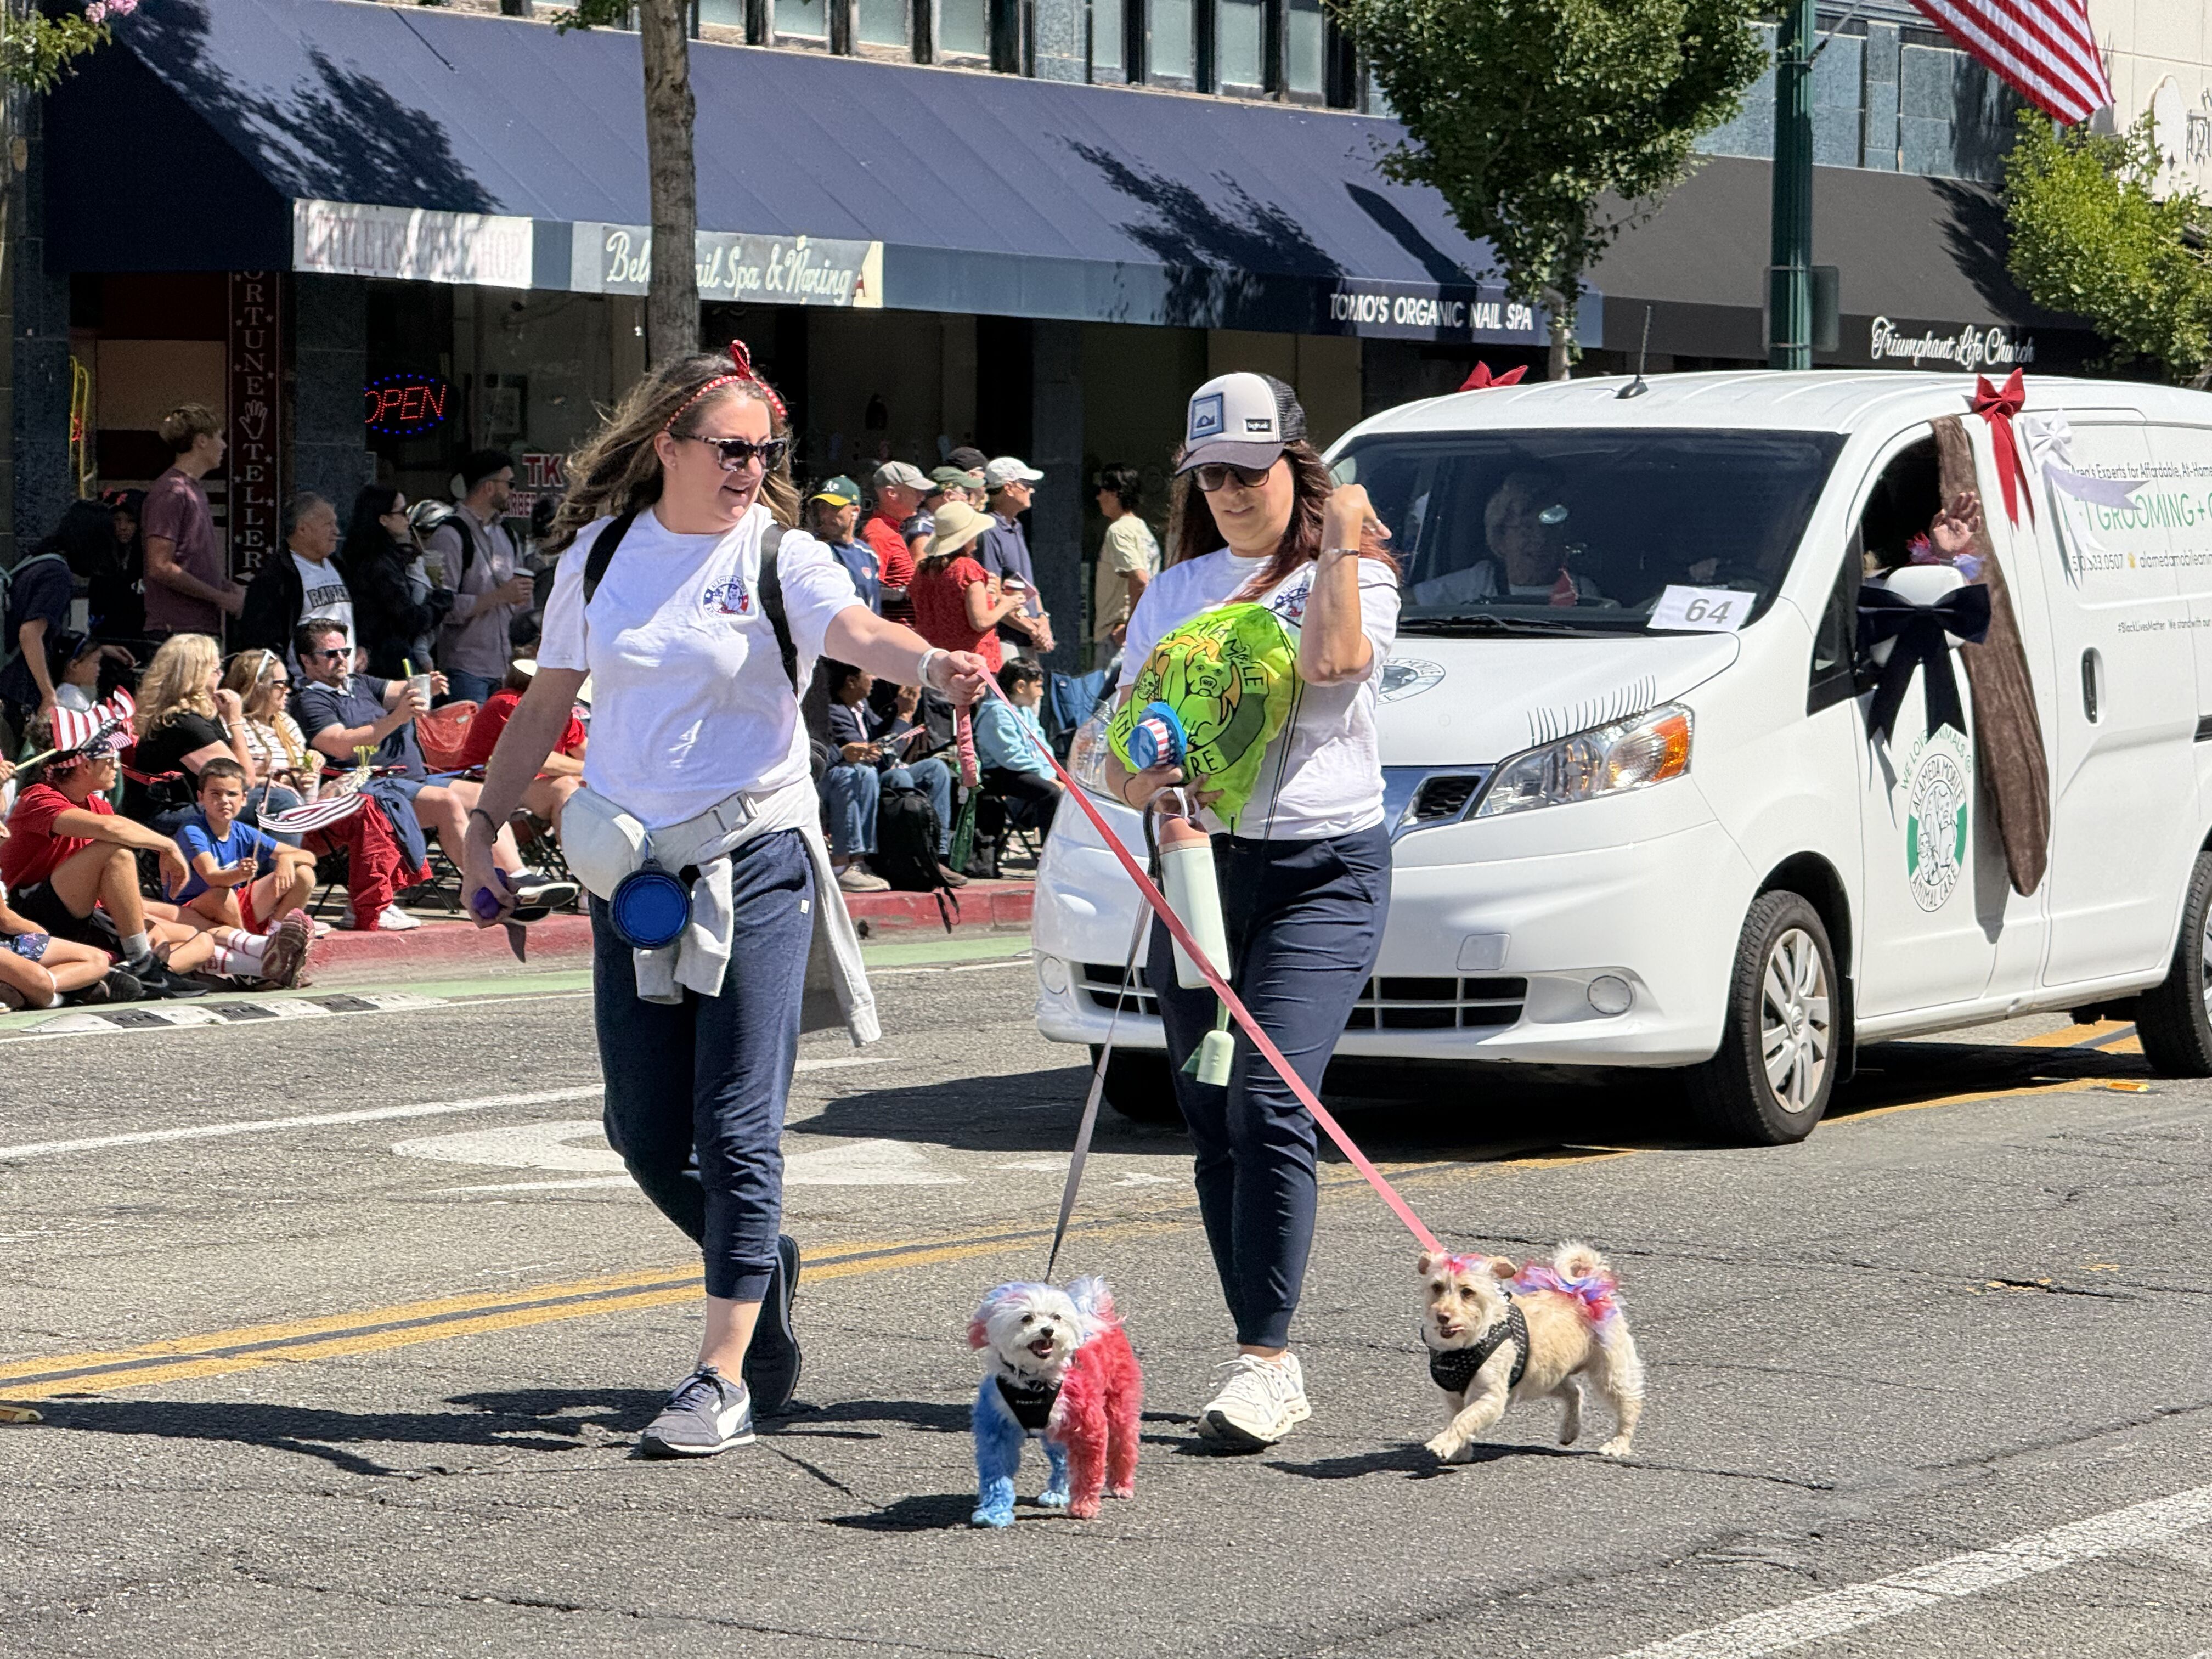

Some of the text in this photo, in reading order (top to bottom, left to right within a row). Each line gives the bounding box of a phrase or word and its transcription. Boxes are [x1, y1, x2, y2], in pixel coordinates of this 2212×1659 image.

[696, 240, 723, 288] ail
[724, 246, 759, 298] Spa
[765, 244, 783, 292] &
[785, 248, 853, 306] Waxing
[1330, 294, 1533, 330] TOMO'S ORGANIC NAIL SPA
[1871, 316, 2035, 371] Triumphant Life Church
[364, 383, 447, 424] OPEN
[522, 453, 563, 487] TK
[2096, 464, 2126, 479] Experts
[2127, 462, 2138, 478] for
[2139, 461, 2181, 479] Affordable,
[242, 443, 265, 568] TELLER
[2096, 493, 2195, 531] GROOMING
[1685, 598, 1733, 624] 64
[1900, 725, 1966, 790] WE LOVE NIMALS
[1912, 758, 1964, 813] ALAMEDA MOBILE
[1912, 865, 1957, 907] ANIMAL CARE
